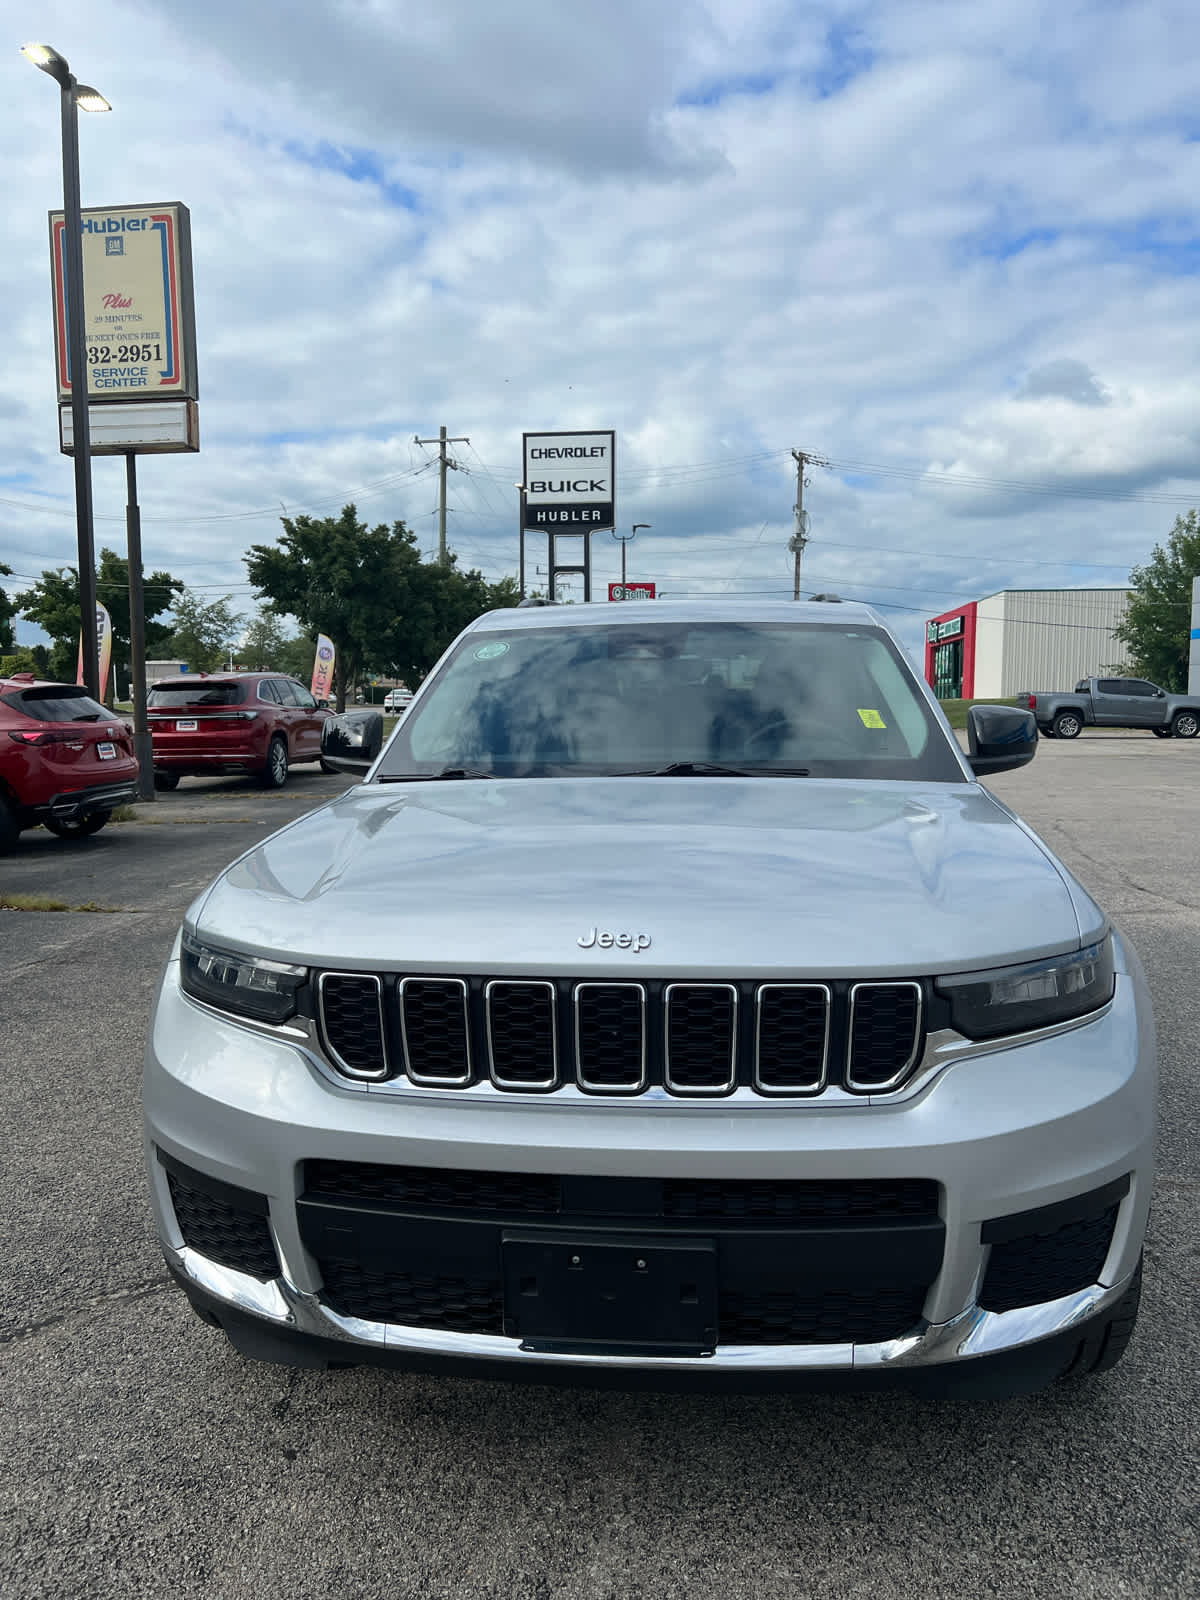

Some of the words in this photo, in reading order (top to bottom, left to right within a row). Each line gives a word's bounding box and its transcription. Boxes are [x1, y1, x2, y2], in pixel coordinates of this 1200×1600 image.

[80, 217, 148, 233] Hubler
[102, 293, 133, 309] Plus
[105, 313, 143, 323] MINUTES
[141, 332, 161, 340] FREE
[87, 344, 163, 364] 32-2951
[92, 367, 149, 378] SERVICE
[94, 378, 147, 388] CENTER
[530, 446, 607, 459] CHEVROLET
[530, 480, 607, 493] BUICK
[537, 510, 601, 522] HUBLER
[576, 927, 652, 953] Jeep
